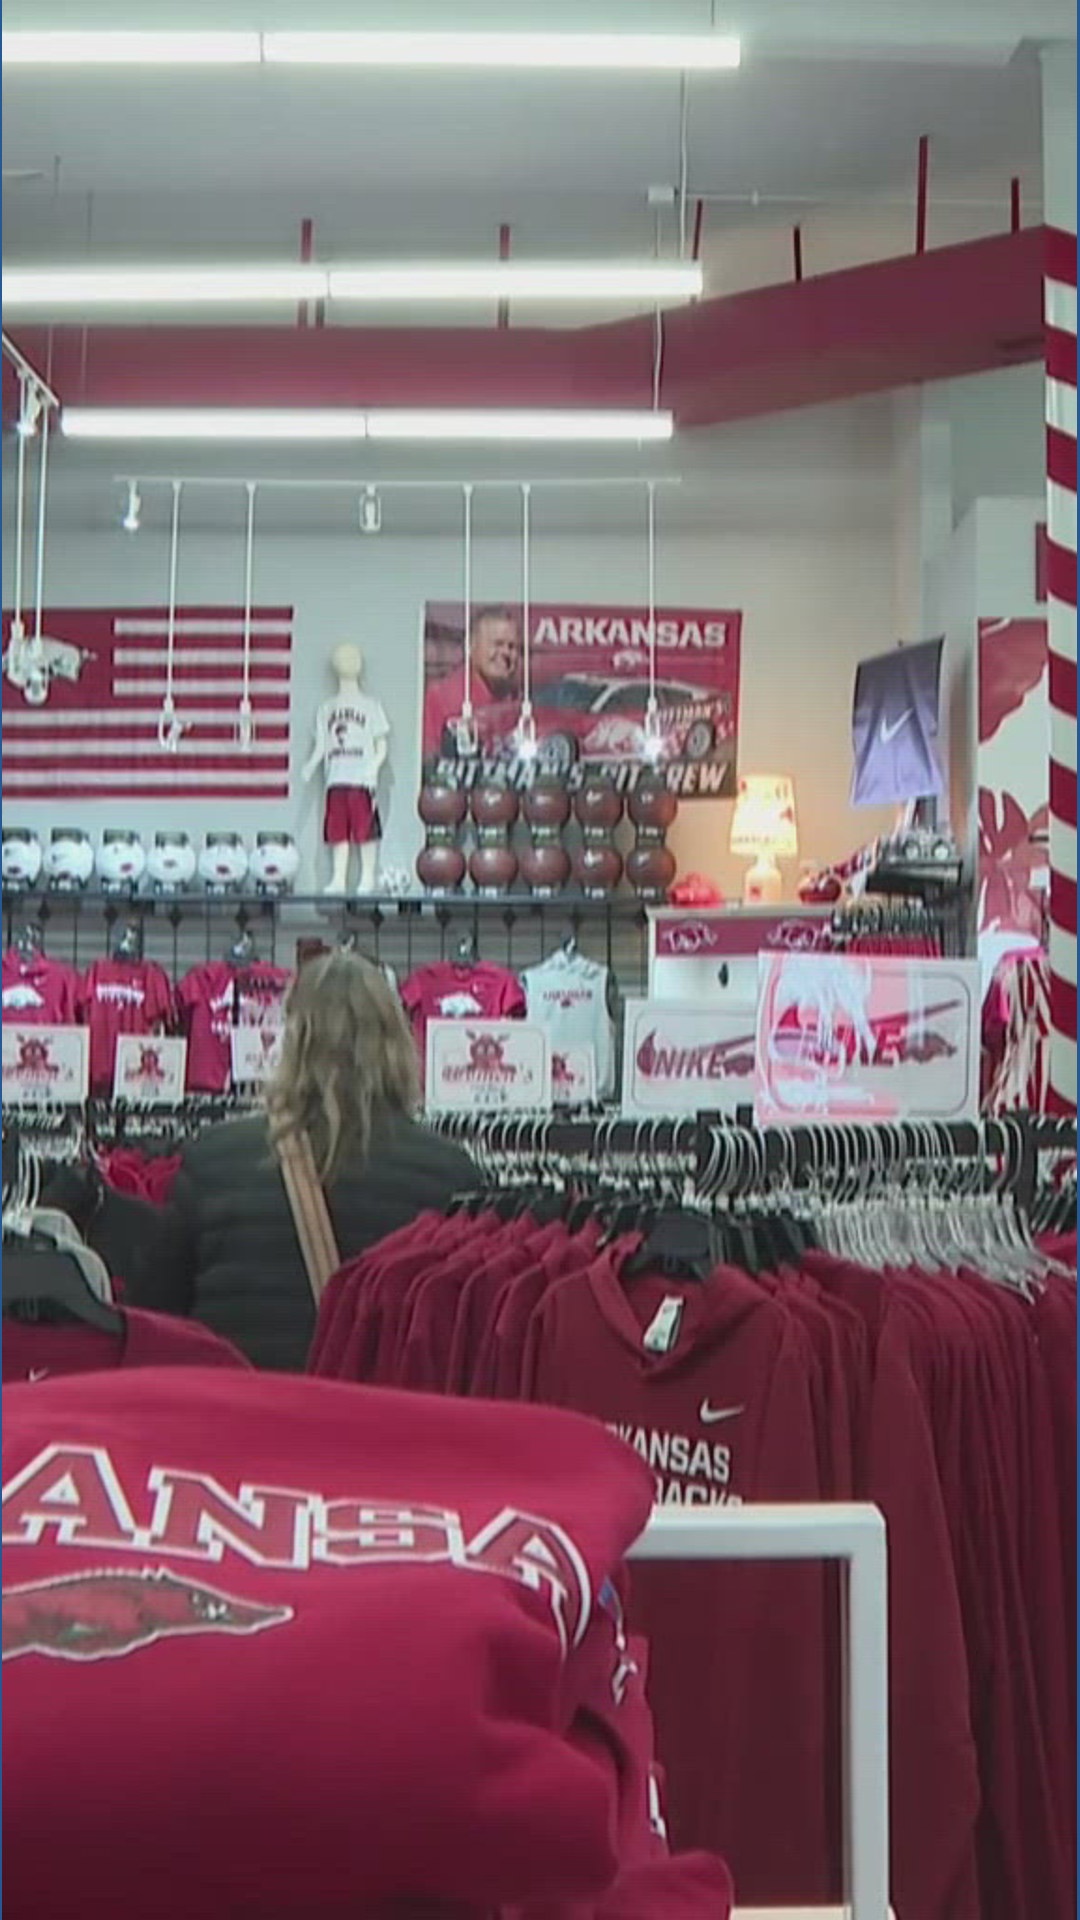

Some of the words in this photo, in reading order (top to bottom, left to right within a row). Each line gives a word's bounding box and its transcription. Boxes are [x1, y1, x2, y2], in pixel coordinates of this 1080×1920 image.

[535, 616, 726, 648] ARKANSAS
[655, 762, 728, 794] REW
[655, 1047, 723, 1078] NIKE
